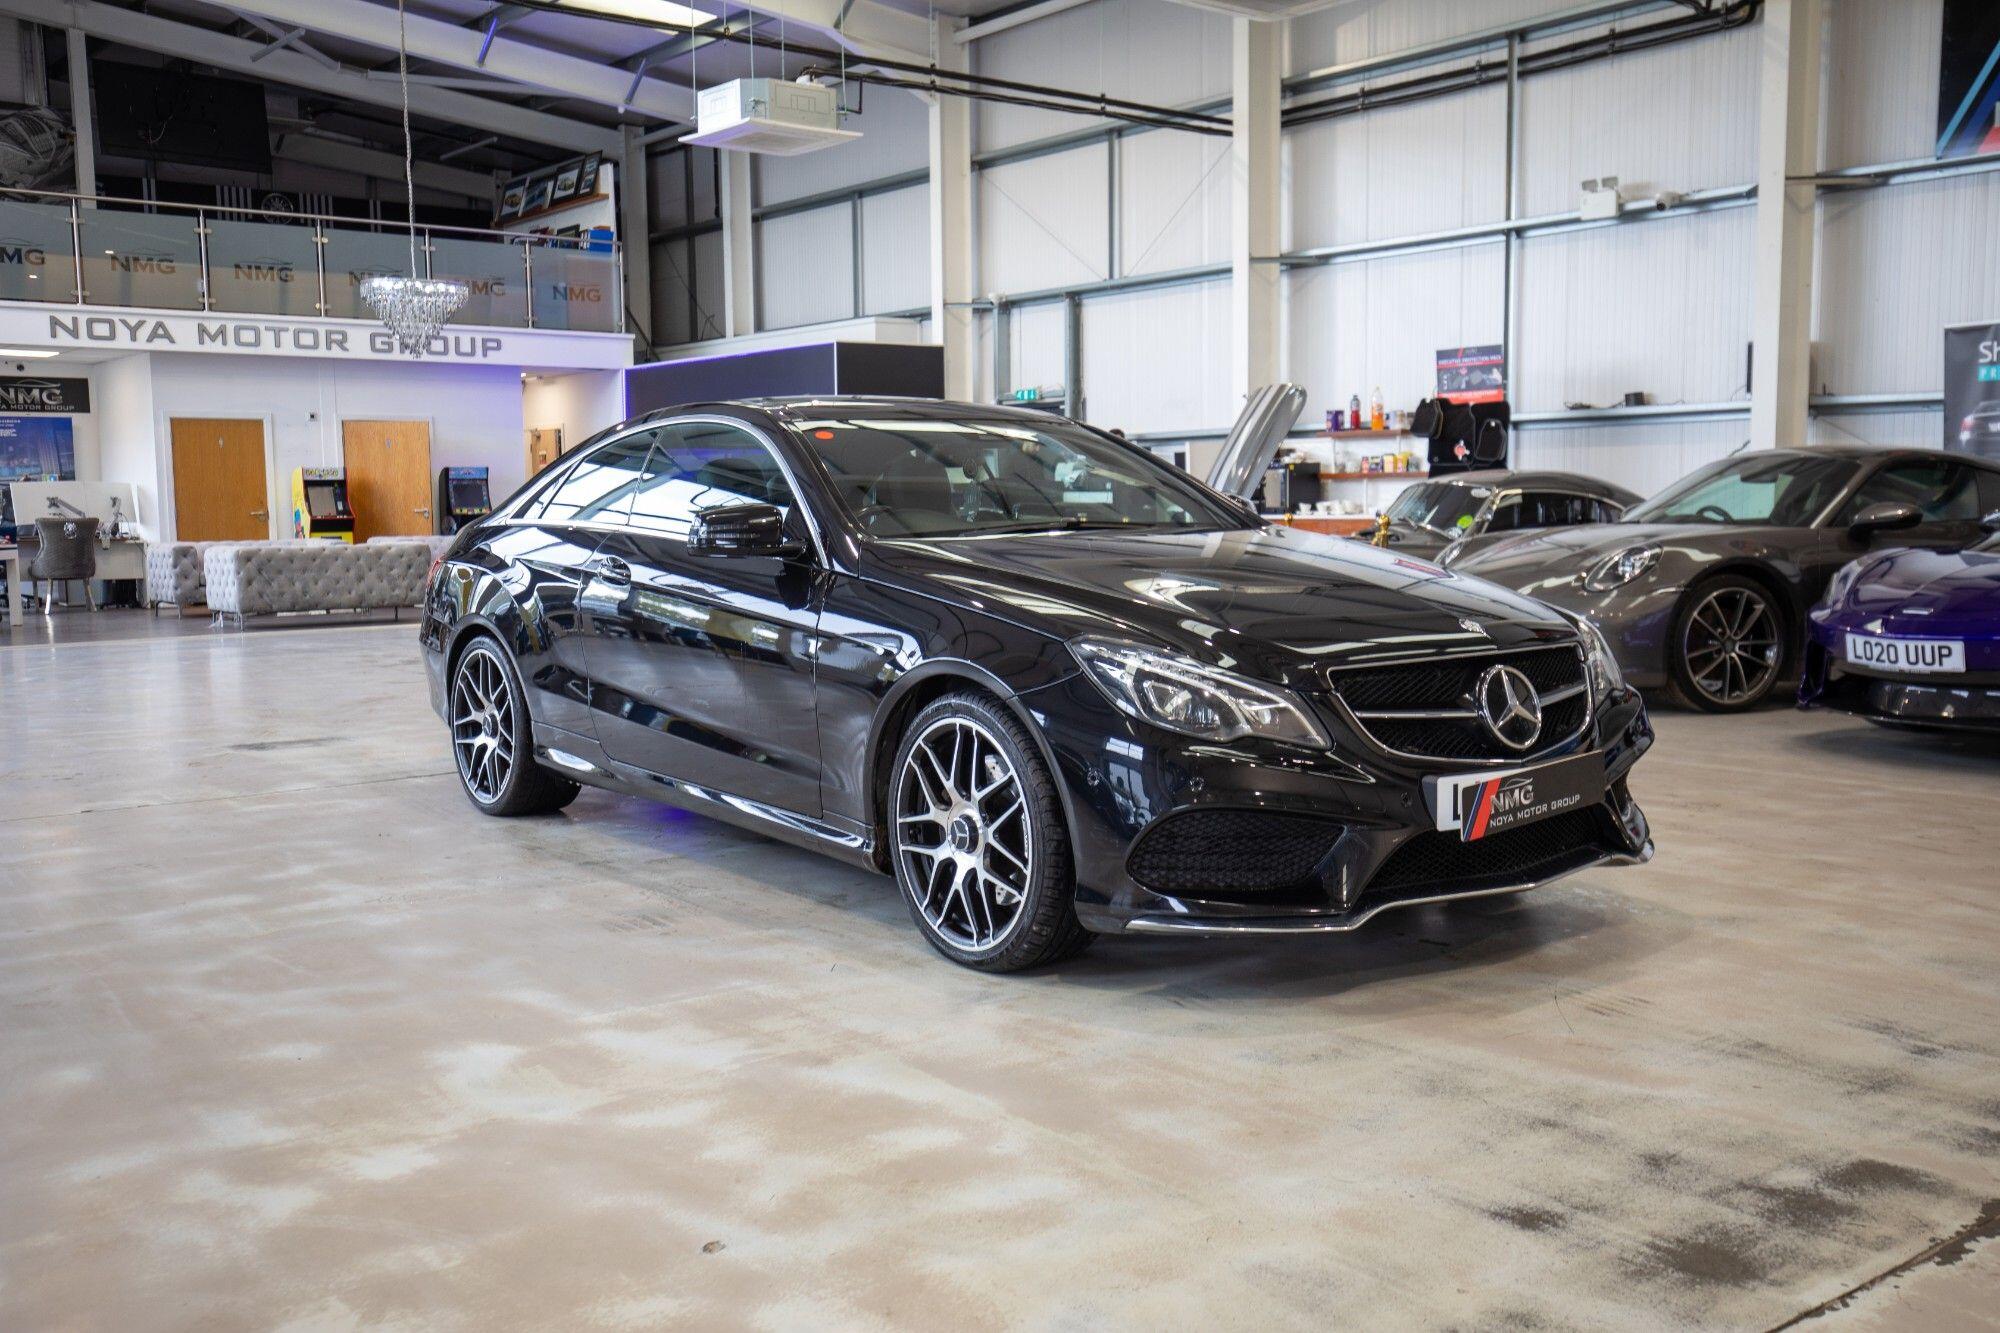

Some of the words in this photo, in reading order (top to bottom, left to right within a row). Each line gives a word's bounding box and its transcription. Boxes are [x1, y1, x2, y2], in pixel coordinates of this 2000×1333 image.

[110, 254, 176, 275] NMG
[234, 263, 294, 283] NMG
[552, 284, 601, 302] NMG
[49, 315, 176, 344] NOYA
[198, 322, 349, 352] MOTOR
[369, 331, 502, 358] GOUP
[1905, 644, 1953, 667] UUP
[1490, 784, 1534, 814] NMG
[1490, 813, 1514, 828] NOYA
[1517, 803, 1548, 819] MOTOR
[1551, 794, 1581, 810] GROUP
